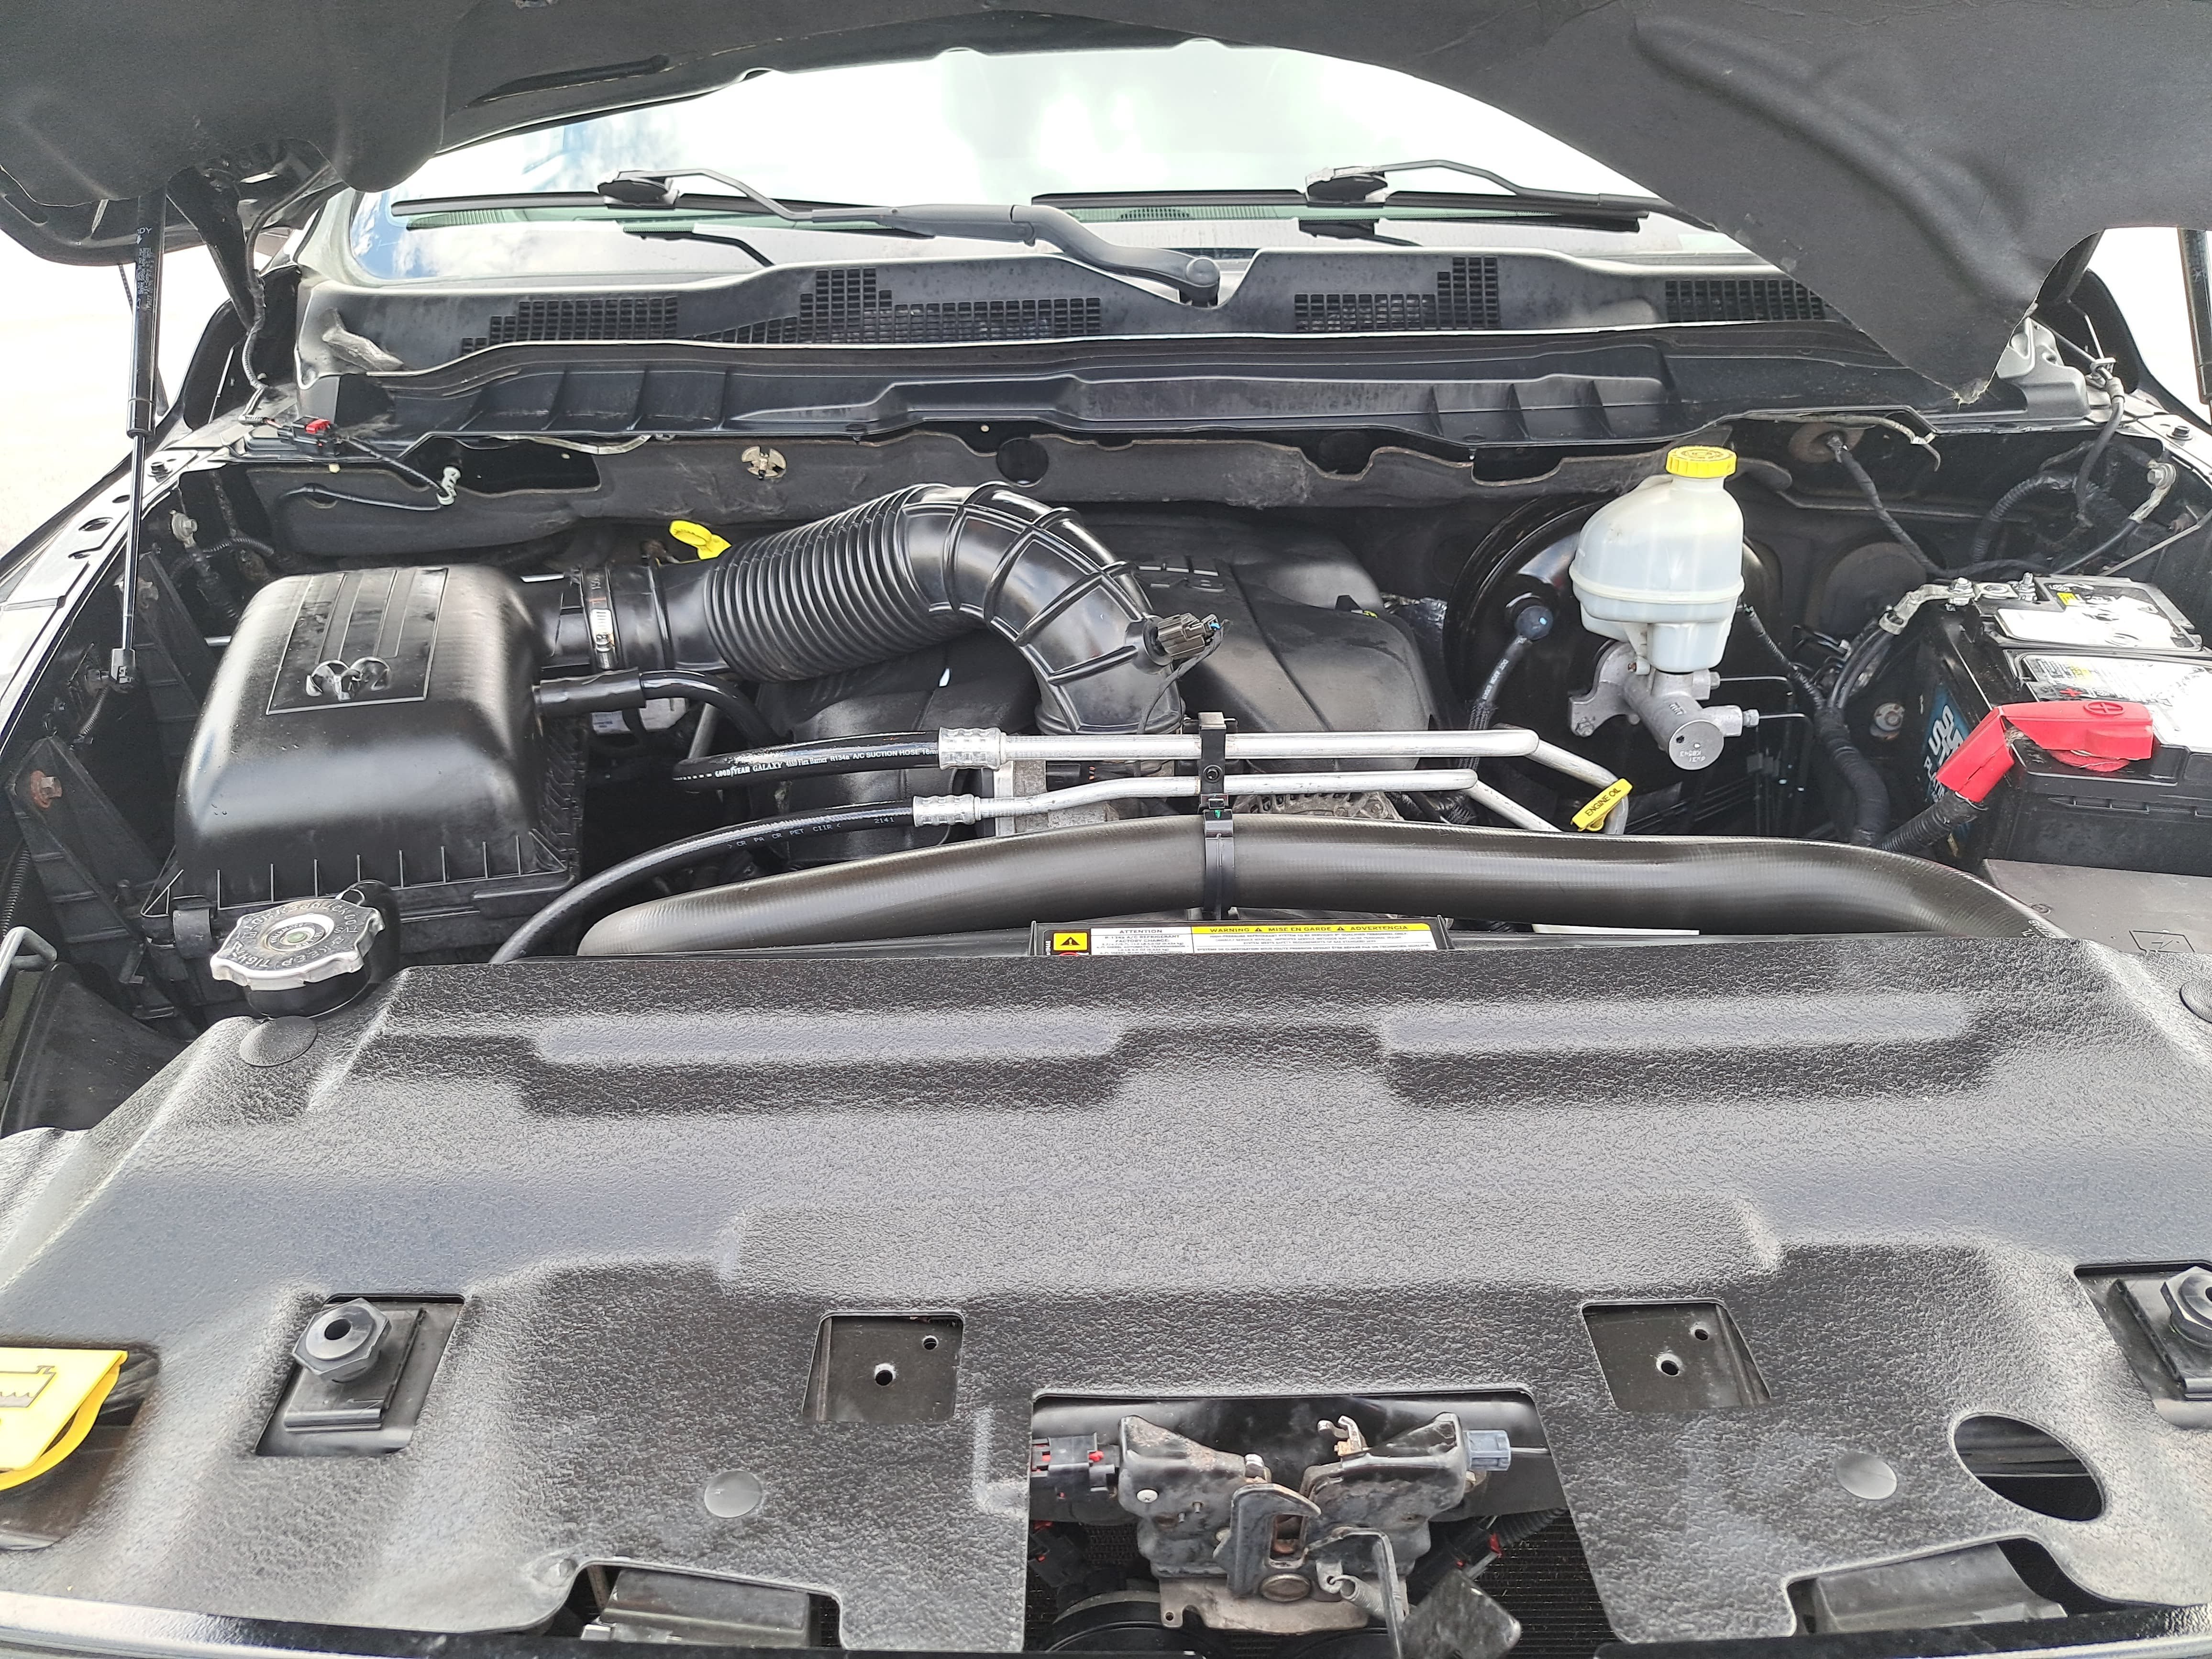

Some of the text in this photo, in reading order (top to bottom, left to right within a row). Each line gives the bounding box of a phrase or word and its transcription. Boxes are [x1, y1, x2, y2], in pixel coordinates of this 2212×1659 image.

[715, 765, 751, 777] GOODYEAR
[752, 762, 783, 772] GALAXY
[798, 758, 809, 766] Flex
[810, 756, 828, 764] Barrier
[866, 750, 898, 758] SUCTION
[1584, 788, 1621, 816] ENGINE OIL
[282, 946, 332, 966] KEEP
